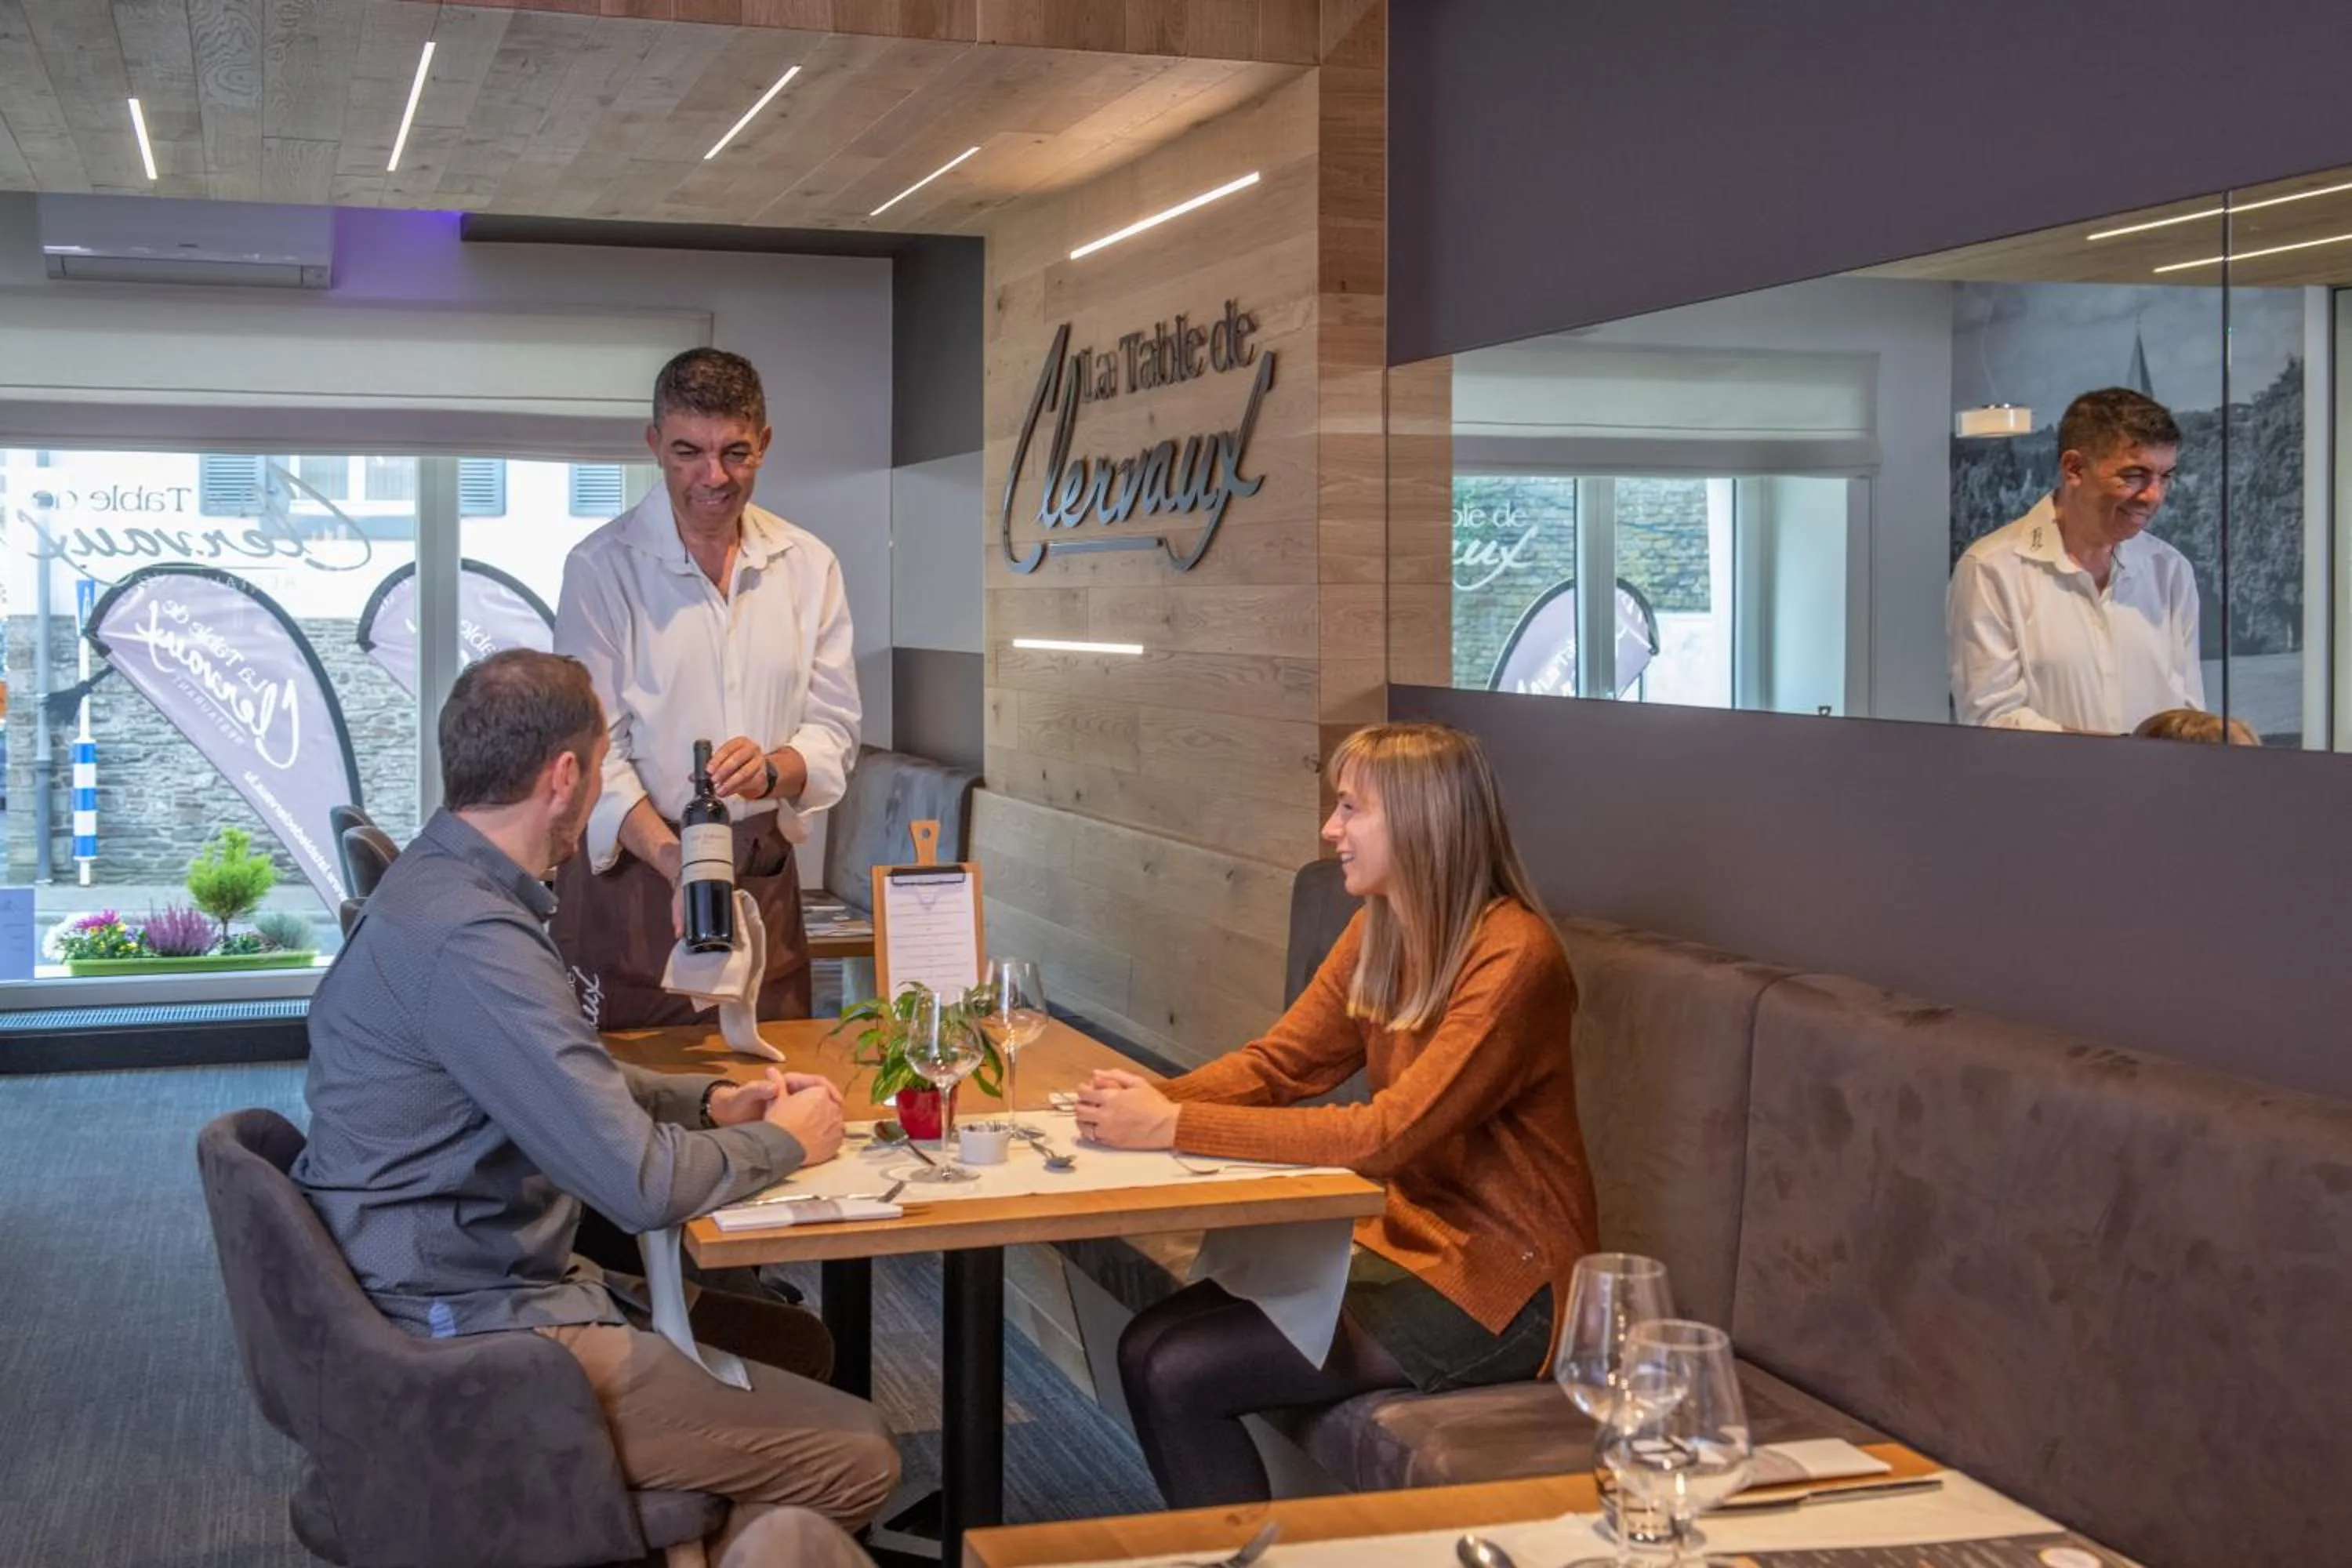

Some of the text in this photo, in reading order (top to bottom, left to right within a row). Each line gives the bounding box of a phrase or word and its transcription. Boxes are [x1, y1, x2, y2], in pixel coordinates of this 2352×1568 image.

[1080, 298, 1256, 404] La Table de
[1493, 499, 1528, 528] de
